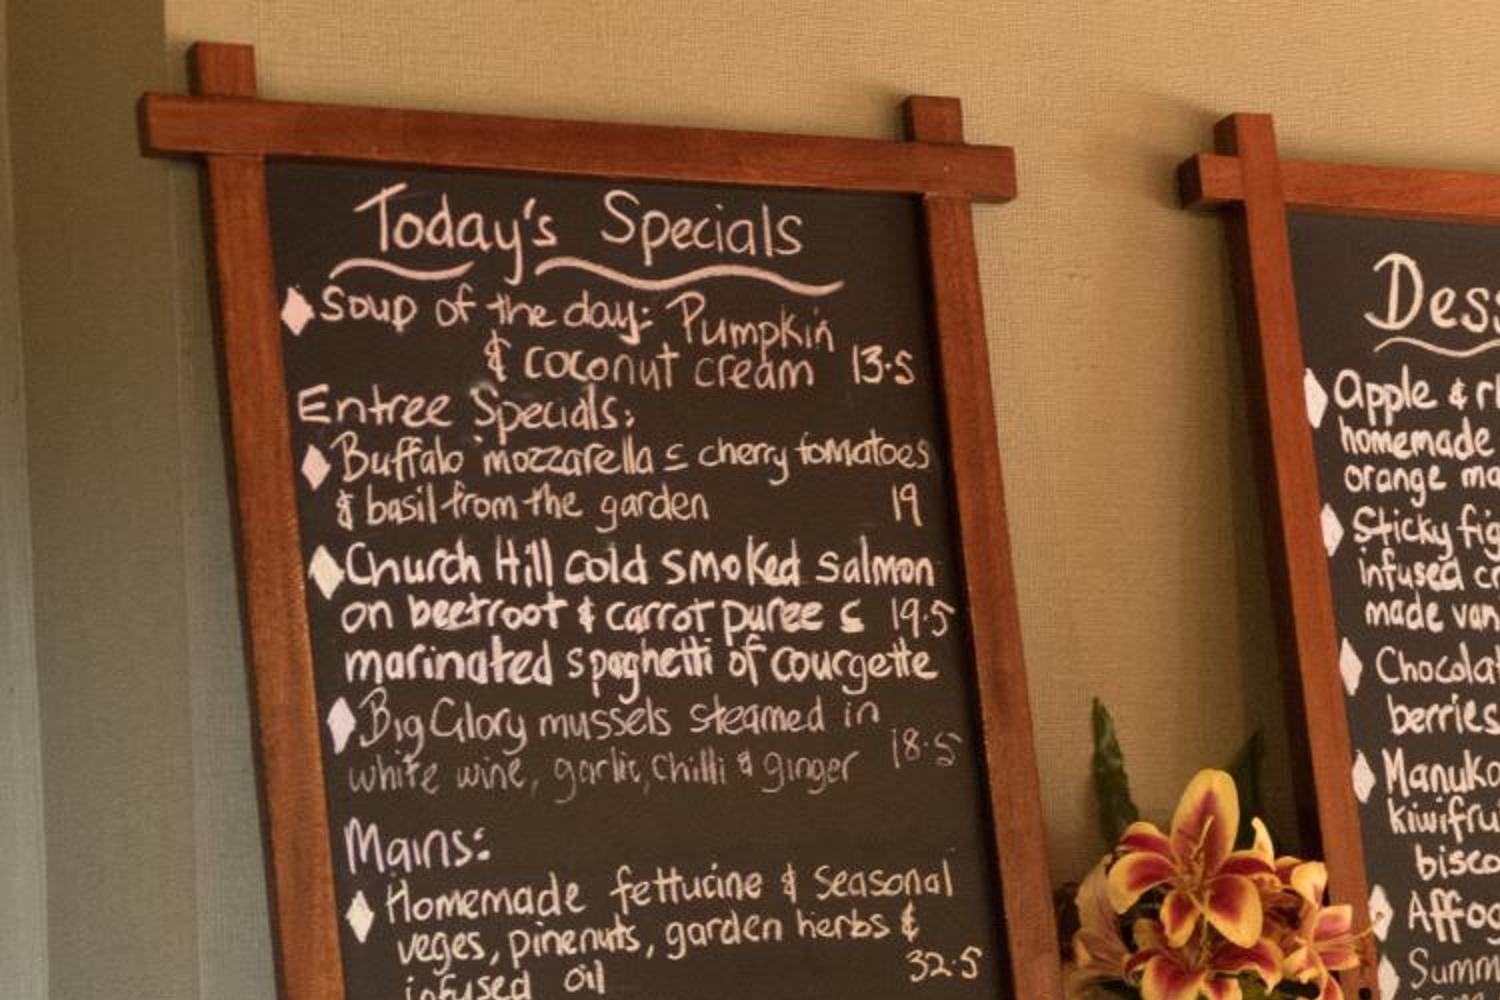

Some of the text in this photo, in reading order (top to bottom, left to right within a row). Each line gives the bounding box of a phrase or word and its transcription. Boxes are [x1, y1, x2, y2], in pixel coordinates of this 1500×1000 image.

[353, 182, 803, 286] Today's Specials
[320, 282, 835, 361] Soup of the day: Pumpkin
[484, 329, 512, 382] &
[524, 341, 680, 390] coconut
[695, 353, 815, 389] cream
[297, 381, 635, 446] Entree Specials:
[1449, 376, 1469, 412] &
[330, 430, 464, 482] Buffalo
[482, 434, 654, 477] mozzarella
[698, 436, 789, 485] cherry
[794, 428, 930, 470] tomatoes
[1338, 414, 1496, 461] homemade
[335, 479, 924, 534] & basil from the garden 19
[1344, 463, 1448, 508] orange
[345, 533, 936, 588] Church Hill cold smoked salmon
[1352, 504, 1454, 562] Sticky
[1357, 546, 1465, 593] infused
[340, 599, 395, 634] on
[407, 590, 569, 632] beetroot
[576, 593, 597, 634] &
[604, 597, 716, 634] carrot
[722, 596, 825, 647] puree
[1364, 592, 1445, 634] made
[345, 633, 940, 705] marinated spaghetti of courgette
[358, 686, 426, 762] Big
[429, 696, 528, 755] Glory
[538, 695, 673, 741] mussels
[689, 692, 825, 736] steamed
[844, 700, 881, 729] in
[348, 745, 861, 804] white wine, garlic, chilli & ginger
[344, 817, 492, 875] Mains:
[385, 869, 588, 925] Homemade
[780, 861, 798, 905] &
[813, 858, 954, 902] seasonal
[397, 931, 501, 977] veges,
[664, 908, 783, 961] garden
[796, 907, 891, 940] herbs
[901, 900, 920, 944] &
[563, 959, 606, 996] oil
